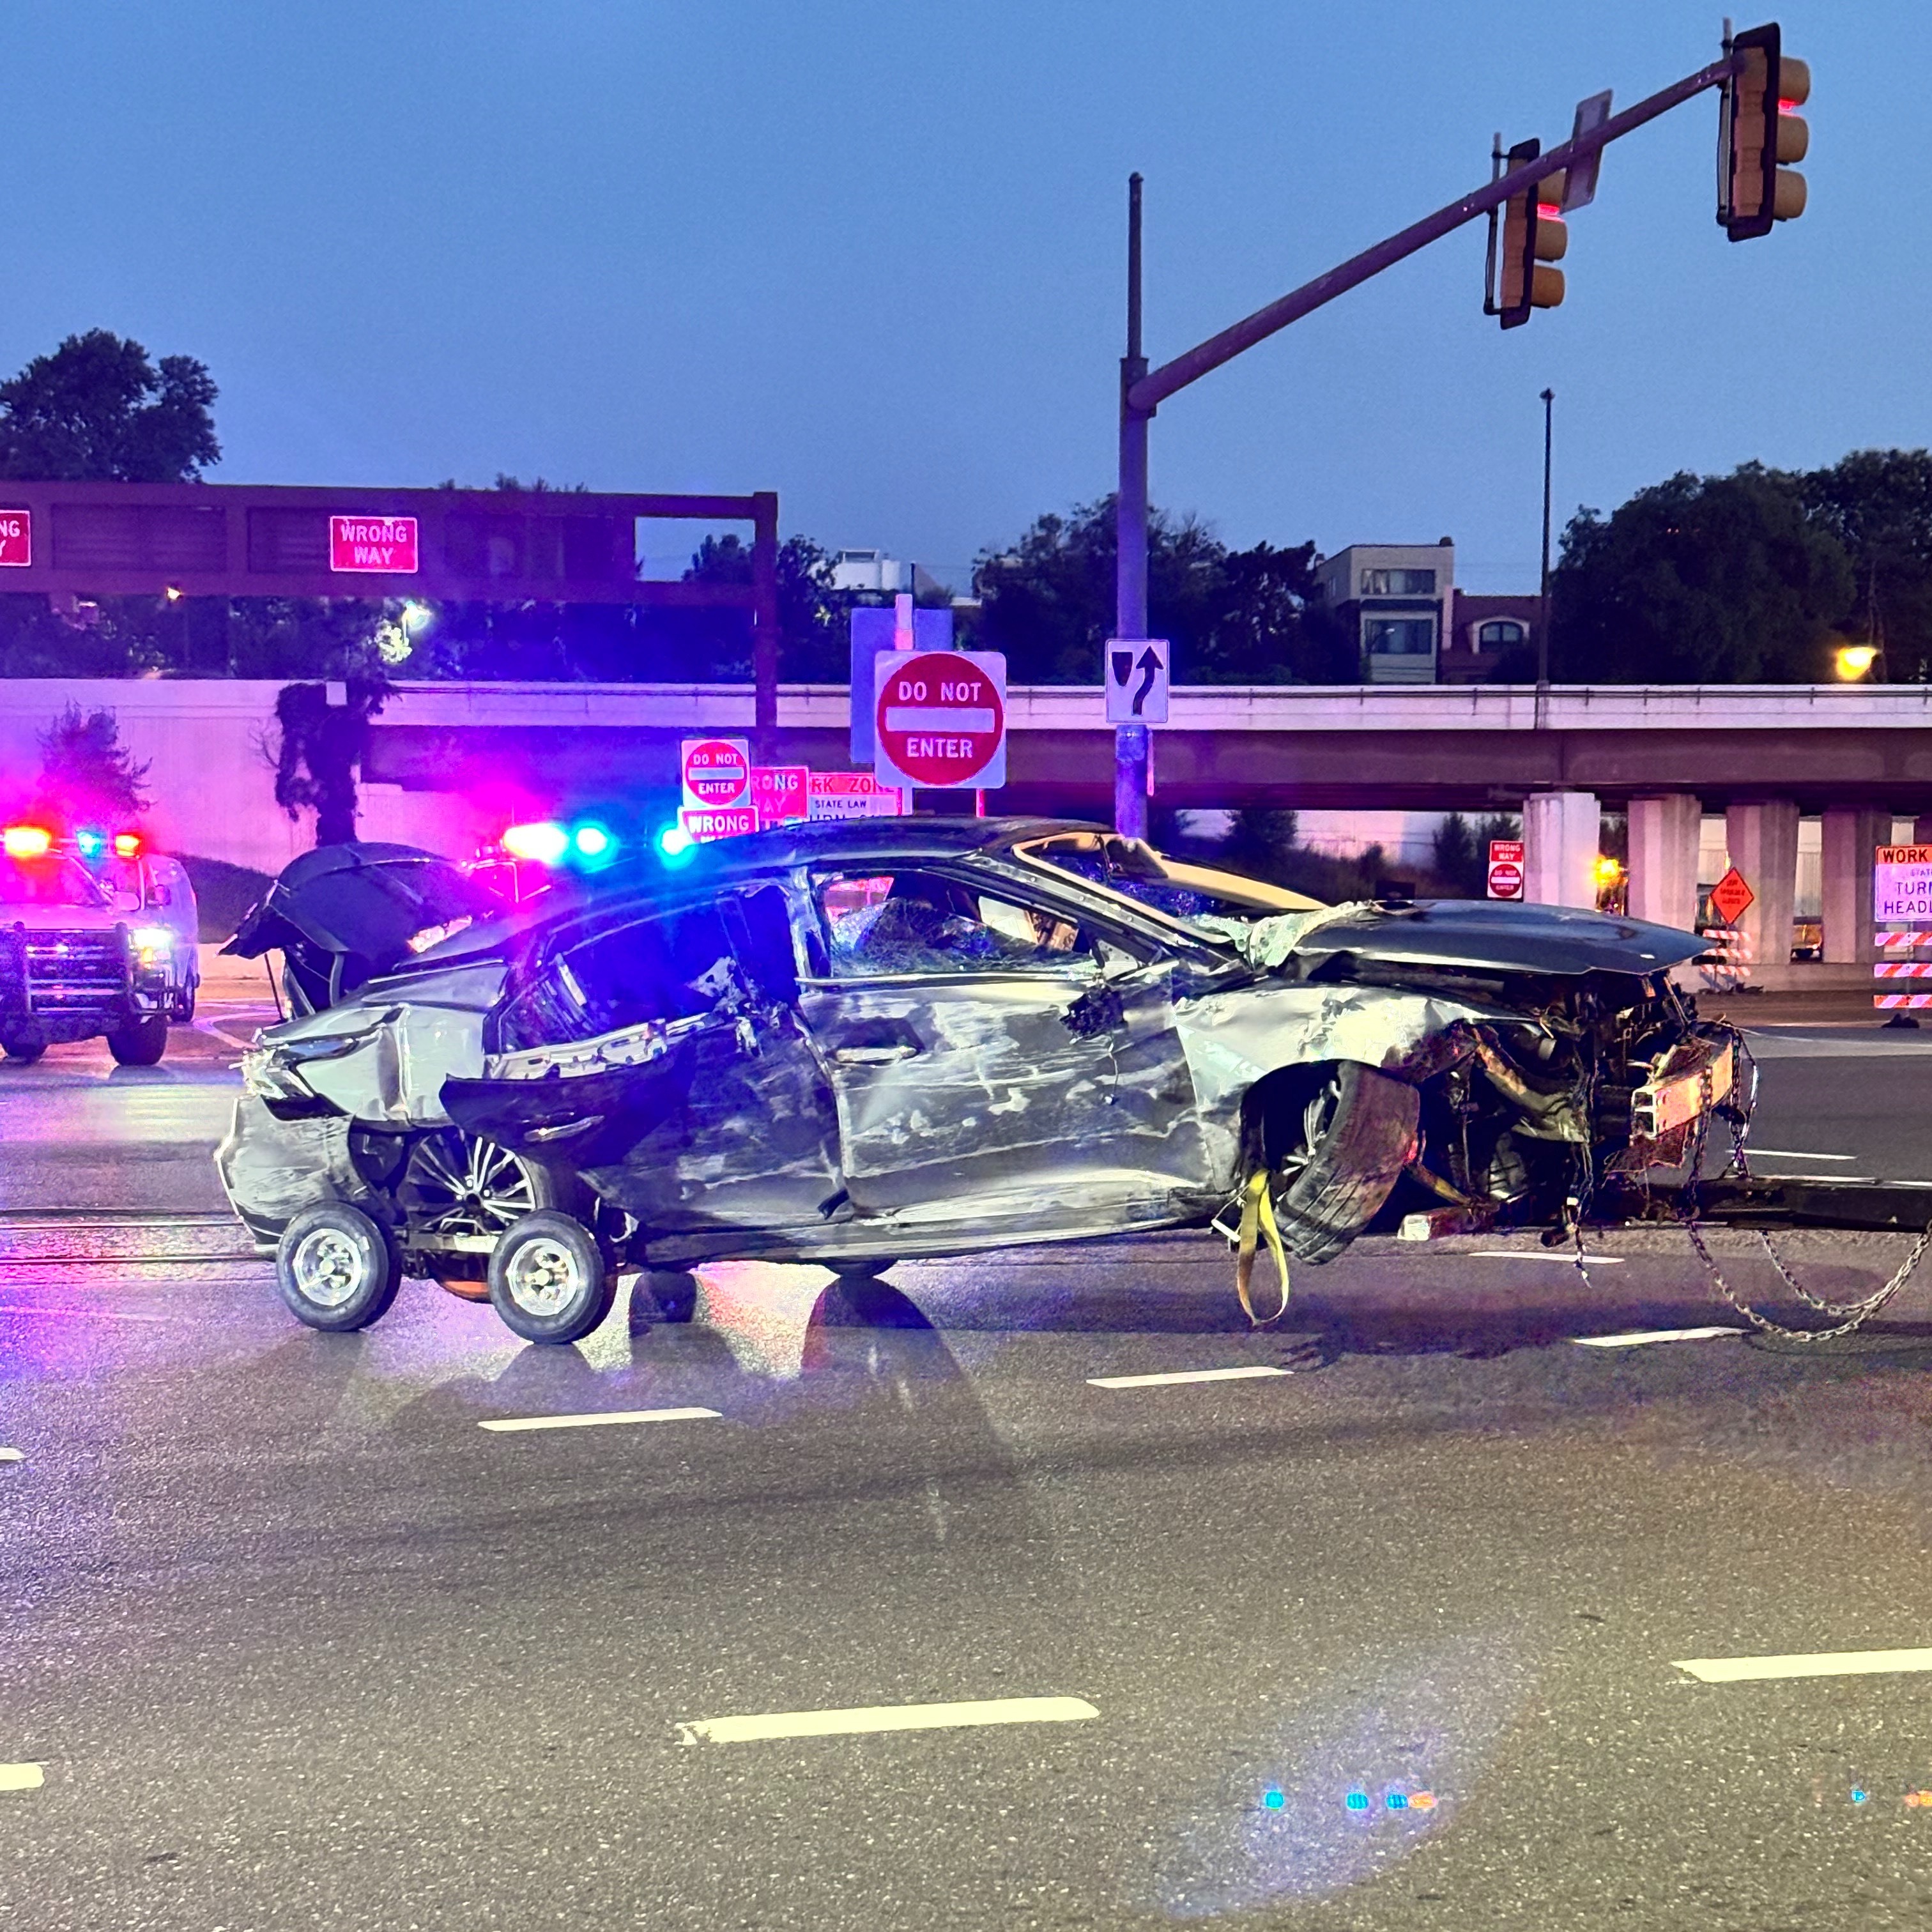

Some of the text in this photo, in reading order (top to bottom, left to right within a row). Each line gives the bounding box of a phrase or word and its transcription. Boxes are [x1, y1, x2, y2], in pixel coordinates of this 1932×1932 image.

[341, 524, 407, 542] WRONG
[354, 546, 394, 564] WAY
[898, 681, 981, 702] DO NOT
[907, 737, 973, 758] ENTER
[693, 753, 738, 765] DO NOT
[698, 783, 735, 795] ENTER
[751, 774, 799, 792] RONG
[812, 778, 834, 793] RK
[755, 797, 786, 813] AY
[815, 800, 843, 808] STATE
[688, 815, 749, 834] WRONG
[1883, 848, 1928, 863] WORK
